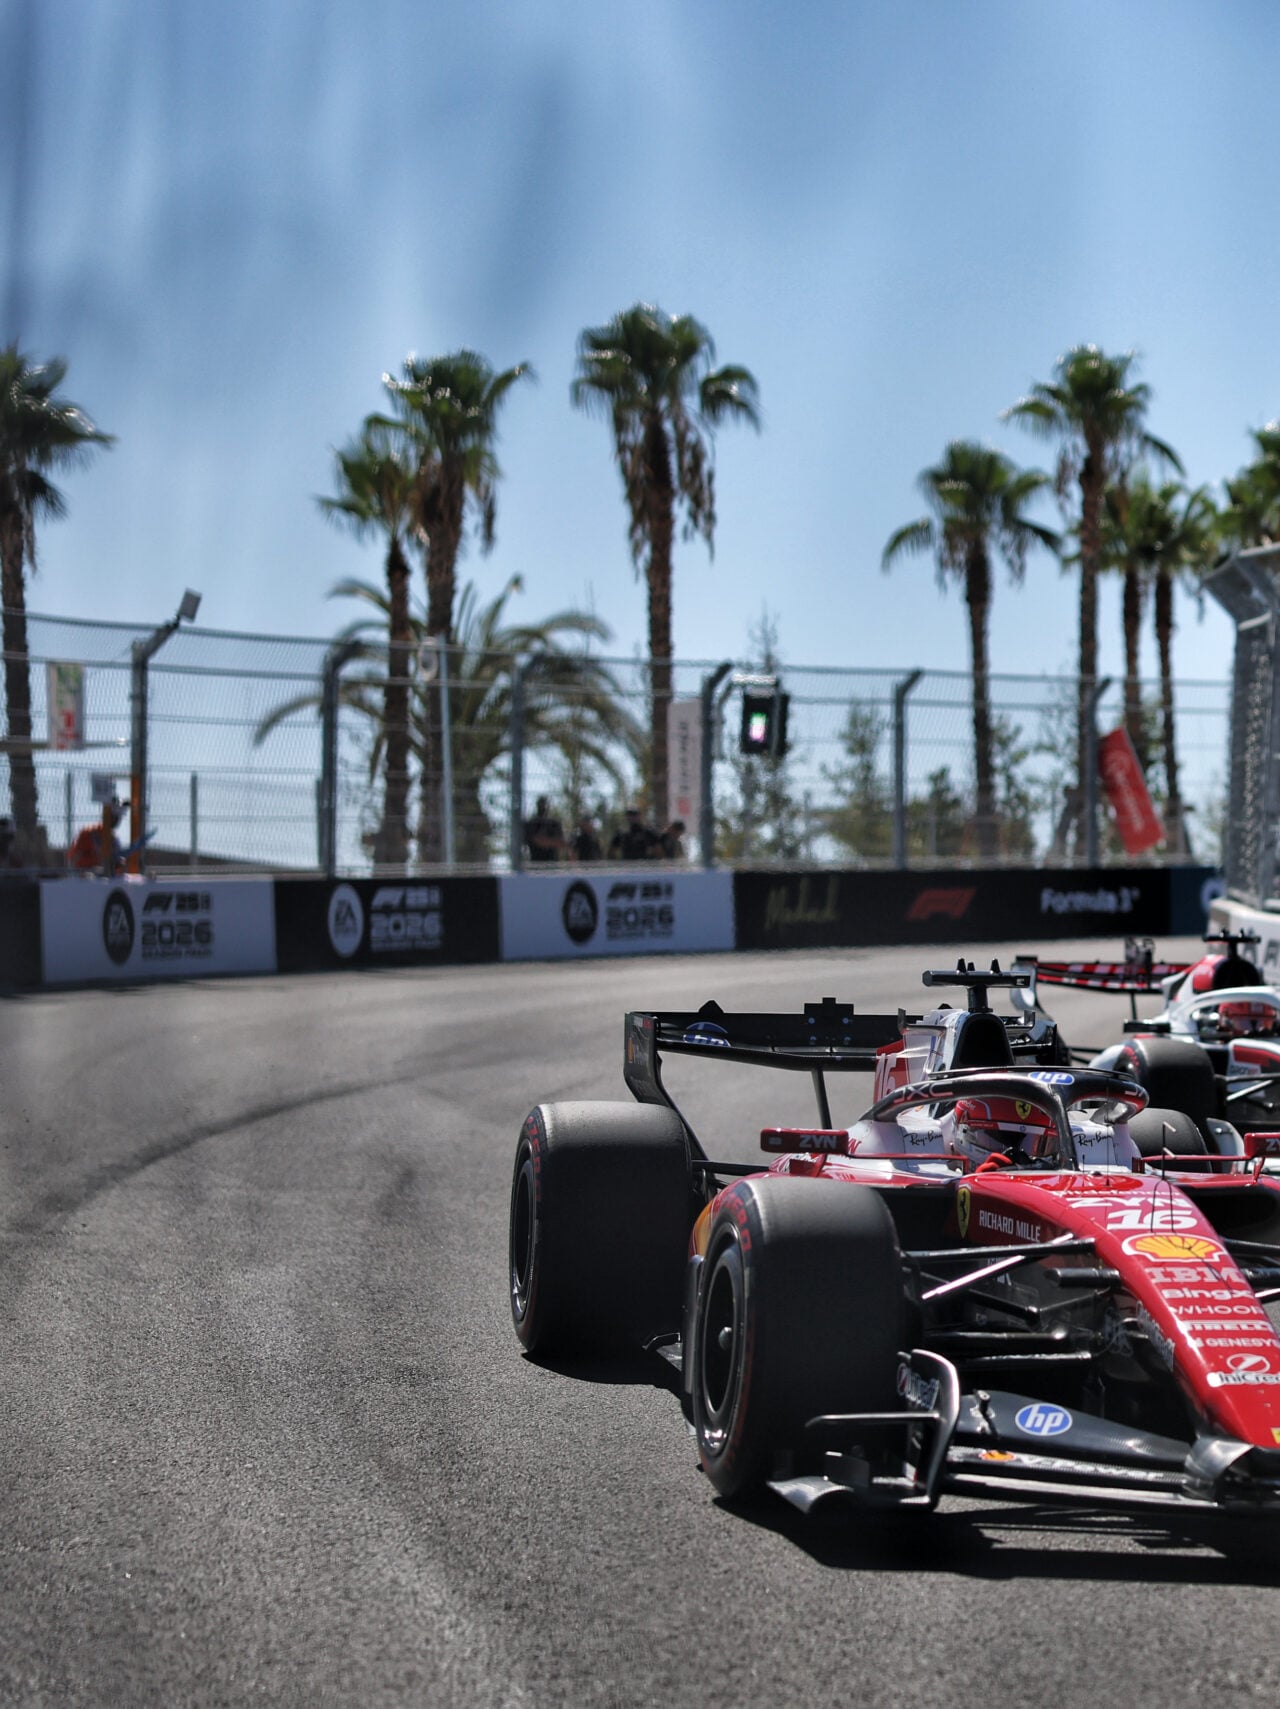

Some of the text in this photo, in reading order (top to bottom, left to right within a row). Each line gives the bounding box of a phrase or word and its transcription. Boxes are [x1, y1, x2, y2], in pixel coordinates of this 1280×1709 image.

[371, 912, 441, 940] 2026
[606, 904, 673, 929] 2026
[142, 920, 212, 945] 2026
[800, 1135, 837, 1149] ZYN
[904, 1130, 943, 1146] Ray-Ban
[1073, 1132, 1113, 1147] Ray-Ban
[1065, 1196, 1193, 1209] ZYN
[979, 1210, 1041, 1244] RICHARD MILLE
[1106, 1208, 1198, 1231] 16
[1145, 1266, 1248, 1284] IBM
[1024, 1404, 1064, 1435] hp
